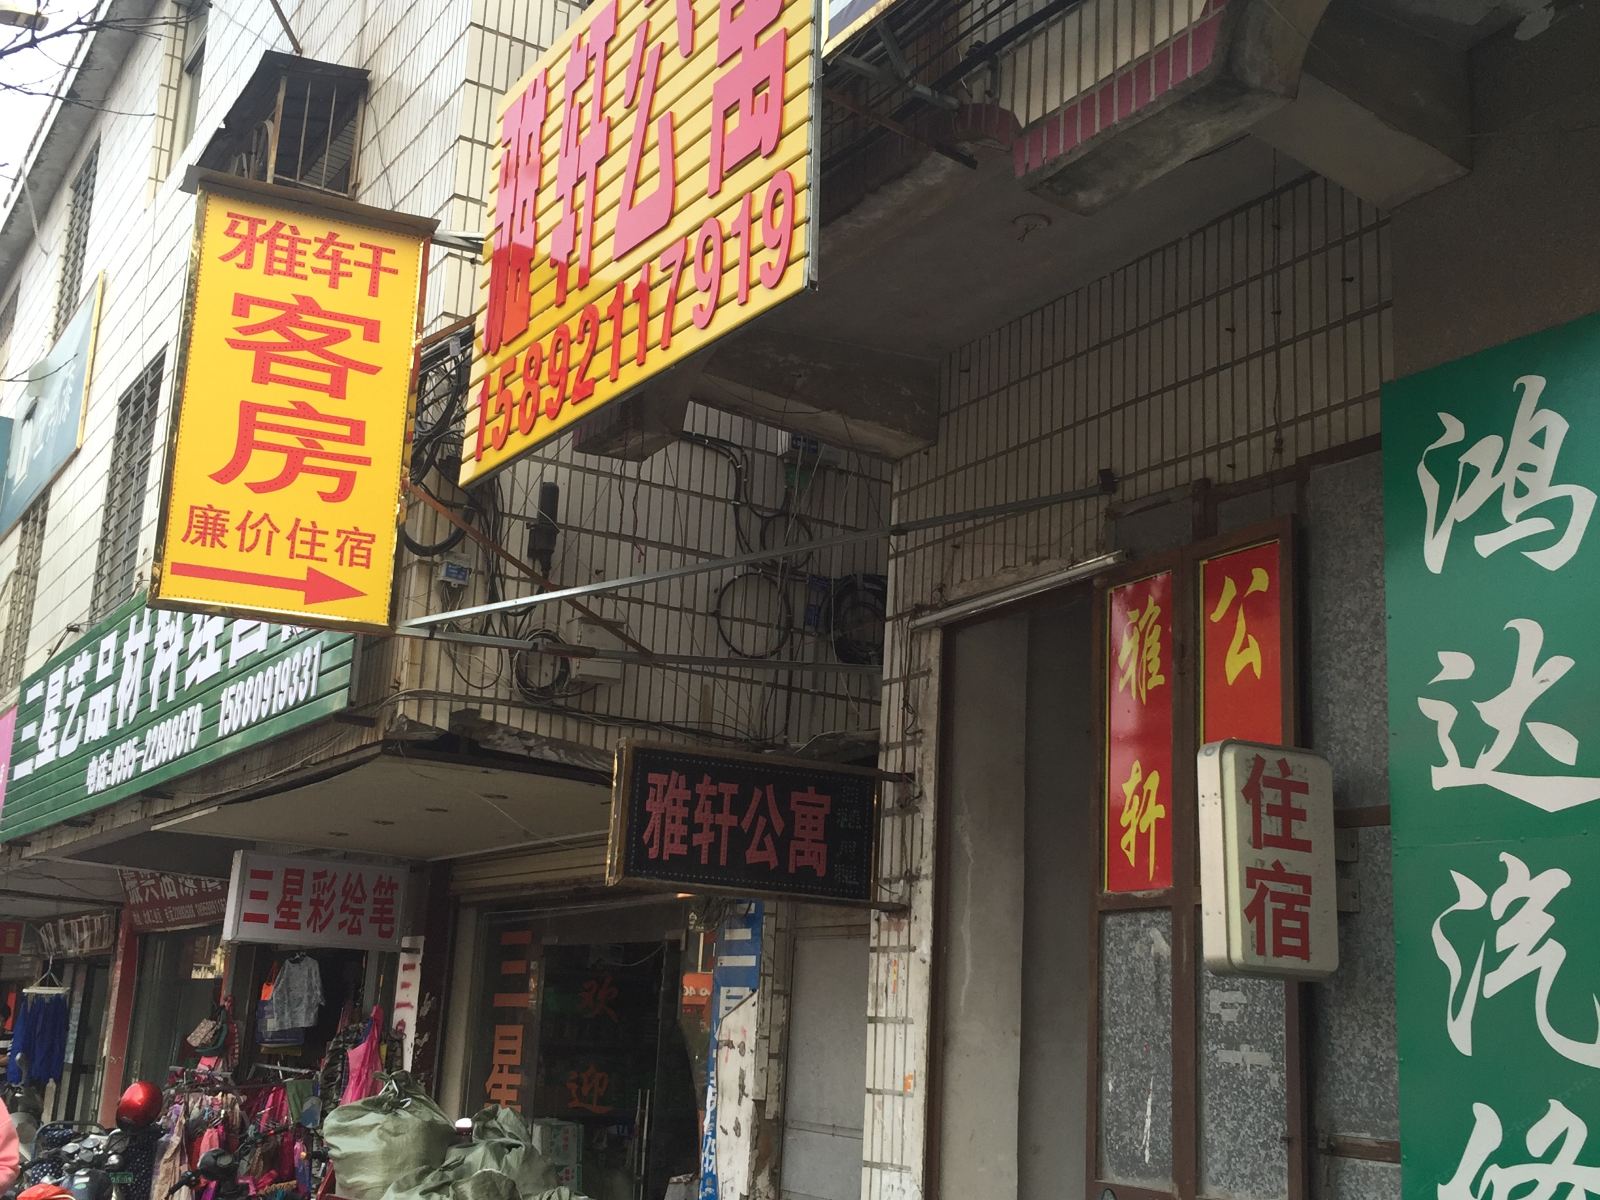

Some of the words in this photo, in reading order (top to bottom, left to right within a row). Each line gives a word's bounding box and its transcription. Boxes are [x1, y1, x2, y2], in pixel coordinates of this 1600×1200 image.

[218, 210, 399, 298] 雅轩
[482, 0, 788, 356] 雅轩公寓
[208, 293, 382, 503] 客房
[475, 170, 796, 462] 15892117919
[181, 504, 377, 570] 廉价住宿
[13, 606, 314, 781] 三星艺品材料经
[217, 640, 324, 738] 15880919331
[1118, 595, 1166, 882] 雅轩
[242, 868, 400, 940] 三星彩绘笔
[642, 769, 832, 878] 雅轩公寓
[1241, 752, 1313, 961] 住宿
